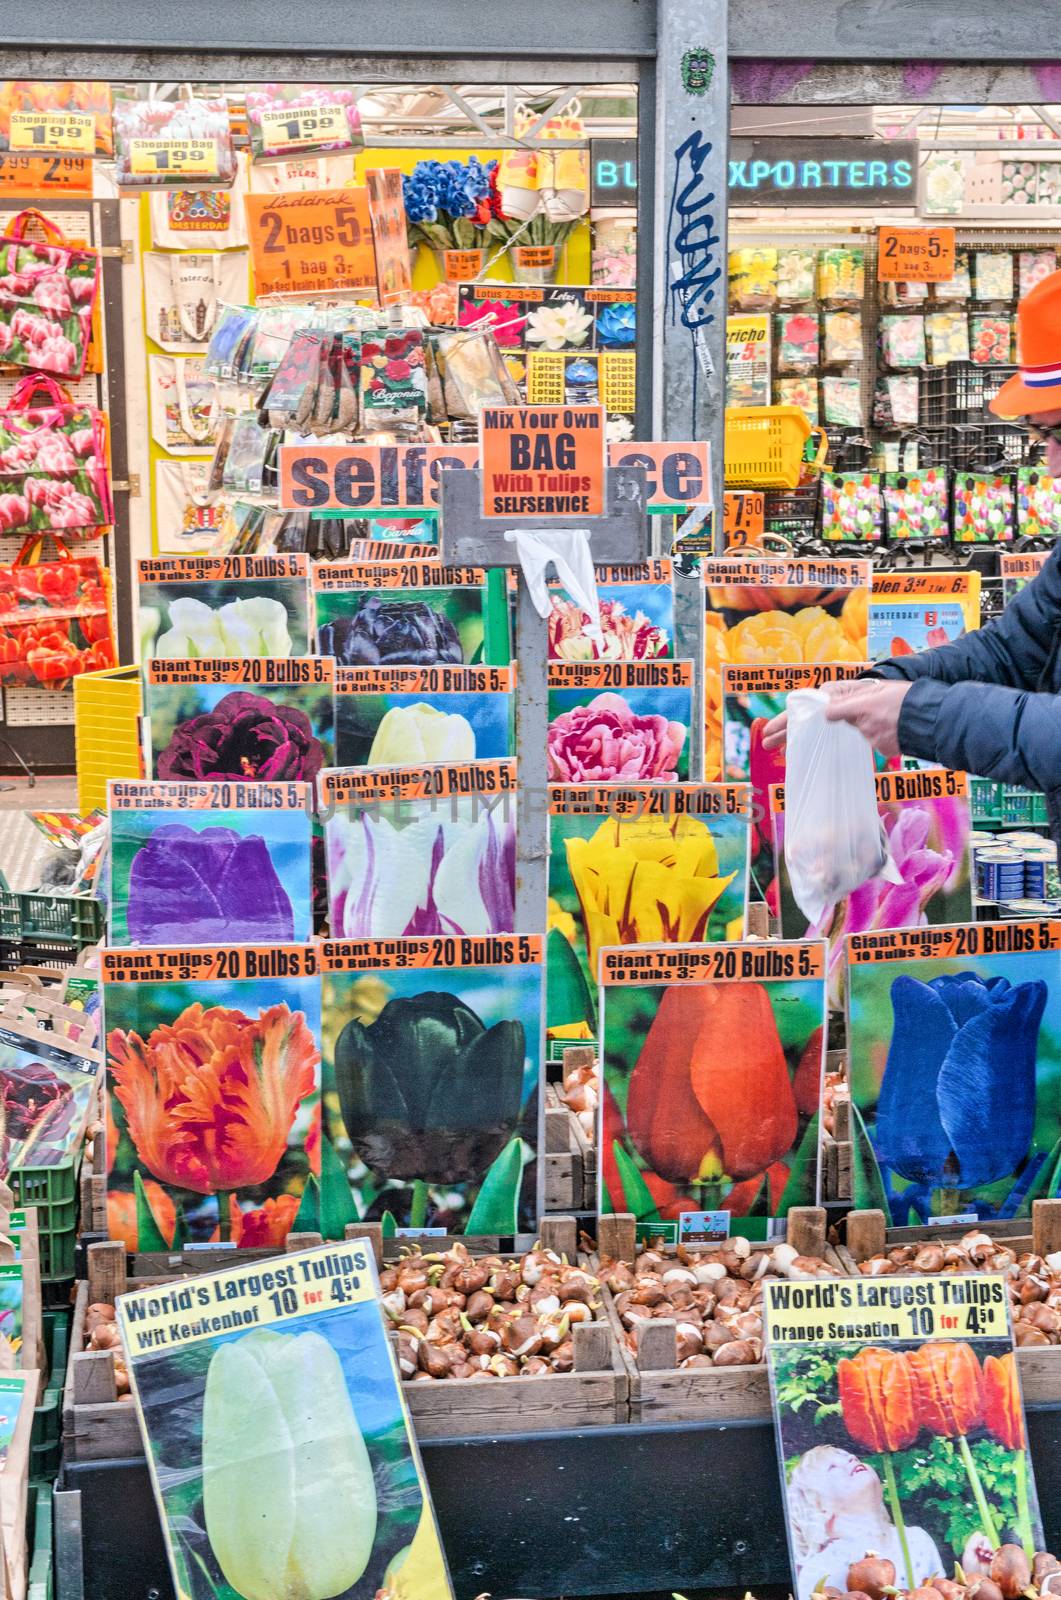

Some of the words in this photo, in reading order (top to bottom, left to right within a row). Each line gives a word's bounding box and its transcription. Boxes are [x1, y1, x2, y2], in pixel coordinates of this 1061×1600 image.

[12, 115, 66, 124] Shopping
[70, 117, 91, 126] Bag
[264, 110, 317, 120] Shopping
[320, 108, 340, 116] Bag
[134, 140, 188, 150] Shopping
[192, 140, 213, 148] Bag
[728, 160, 912, 187] XPORTERS
[260, 212, 285, 253] 2
[286, 225, 335, 244] bags
[885, 237, 897, 257] 2
[900, 245, 926, 255] bags
[281, 260, 291, 279] 1
[301, 261, 327, 274] bag
[476, 289, 502, 298] Lotus
[587, 294, 612, 302] Lotus
[373, 388, 422, 400] Begonia
[485, 411, 514, 429] Mix
[520, 411, 558, 428] Your
[564, 410, 599, 428] Own
[510, 433, 575, 470] BAG
[493, 474, 532, 492] With
[538, 474, 590, 493] Tulips
[494, 496, 589, 513] SELFSERVICE
[141, 560, 176, 571] Giant
[179, 559, 220, 569] Tulips
[224, 557, 240, 578] 20
[246, 556, 285, 577] Bulbs
[318, 569, 354, 579] Giant
[357, 567, 398, 577] Tulips
[401, 566, 418, 586] 20
[423, 565, 462, 585] Bulbs
[707, 564, 741, 574] Giant
[745, 564, 784, 574] Tulips
[788, 564, 803, 584] 20
[808, 564, 847, 584] Bulbs
[1004, 560, 1030, 572] Bulbs
[152, 660, 190, 672] Giant
[194, 660, 239, 672] Tulips
[243, 660, 260, 682] 20
[266, 660, 309, 681] Bulbs
[172, 674, 207, 682] Bulbs
[373, 670, 417, 682] Tulips
[420, 670, 438, 691] 20
[443, 669, 485, 690] Bulbs
[556, 665, 600, 676] Tulips
[604, 664, 621, 686] 20
[626, 664, 668, 685] Bulbs
[728, 670, 764, 681] Giant
[768, 668, 810, 680] Tulips
[352, 683, 386, 691] Bulbs
[747, 682, 780, 690] Bulbs
[326, 775, 368, 789] Giant
[371, 771, 420, 787] Tulips
[449, 767, 495, 793] Bulbs
[896, 773, 941, 800] Bulbs
[114, 784, 154, 796] Giant
[159, 785, 207, 798] Tulips
[211, 784, 230, 809] 20
[236, 783, 282, 808] Bulbs
[118, 799, 130, 808] 10
[136, 799, 171, 808] Bulbs
[851, 934, 896, 949] Giant
[901, 931, 953, 946] Tulips
[956, 928, 977, 955] 20
[984, 925, 1034, 952] Bulbs
[323, 943, 370, 957] Giant
[374, 941, 429, 956] Tulips
[432, 939, 455, 966] 20
[461, 937, 514, 965] Bulbs
[855, 951, 870, 961] 10
[875, 949, 915, 960] Bulbs
[105, 954, 152, 968] Giant
[157, 952, 213, 967] Tulips
[216, 951, 239, 979] 20
[245, 949, 300, 977] Bulbs
[328, 959, 342, 968] 10
[347, 957, 390, 967] Bulbs
[606, 954, 652, 968] Giant
[656, 953, 710, 968] Tulips
[713, 951, 736, 978] 20
[742, 950, 794, 977] Bulbs
[109, 970, 124, 980] 10
[130, 969, 173, 980] Bulbs
[610, 970, 625, 979] 10
[630, 969, 671, 979] Bulbs
[124, 1286, 210, 1322] World's
[214, 1264, 296, 1302] Largest
[299, 1250, 367, 1282] Tulips
[770, 1284, 852, 1310] World's
[857, 1281, 934, 1309] Largest
[939, 1280, 1003, 1306] Tulips
[136, 1327, 167, 1349] Wit
[170, 1305, 260, 1342] Keukenhof
[269, 1288, 299, 1317] 10
[303, 1289, 322, 1305] for
[773, 1324, 823, 1341] Orange
[829, 1322, 899, 1338] Sensation
[907, 1307, 934, 1335] 10
[940, 1314, 958, 1329] for
